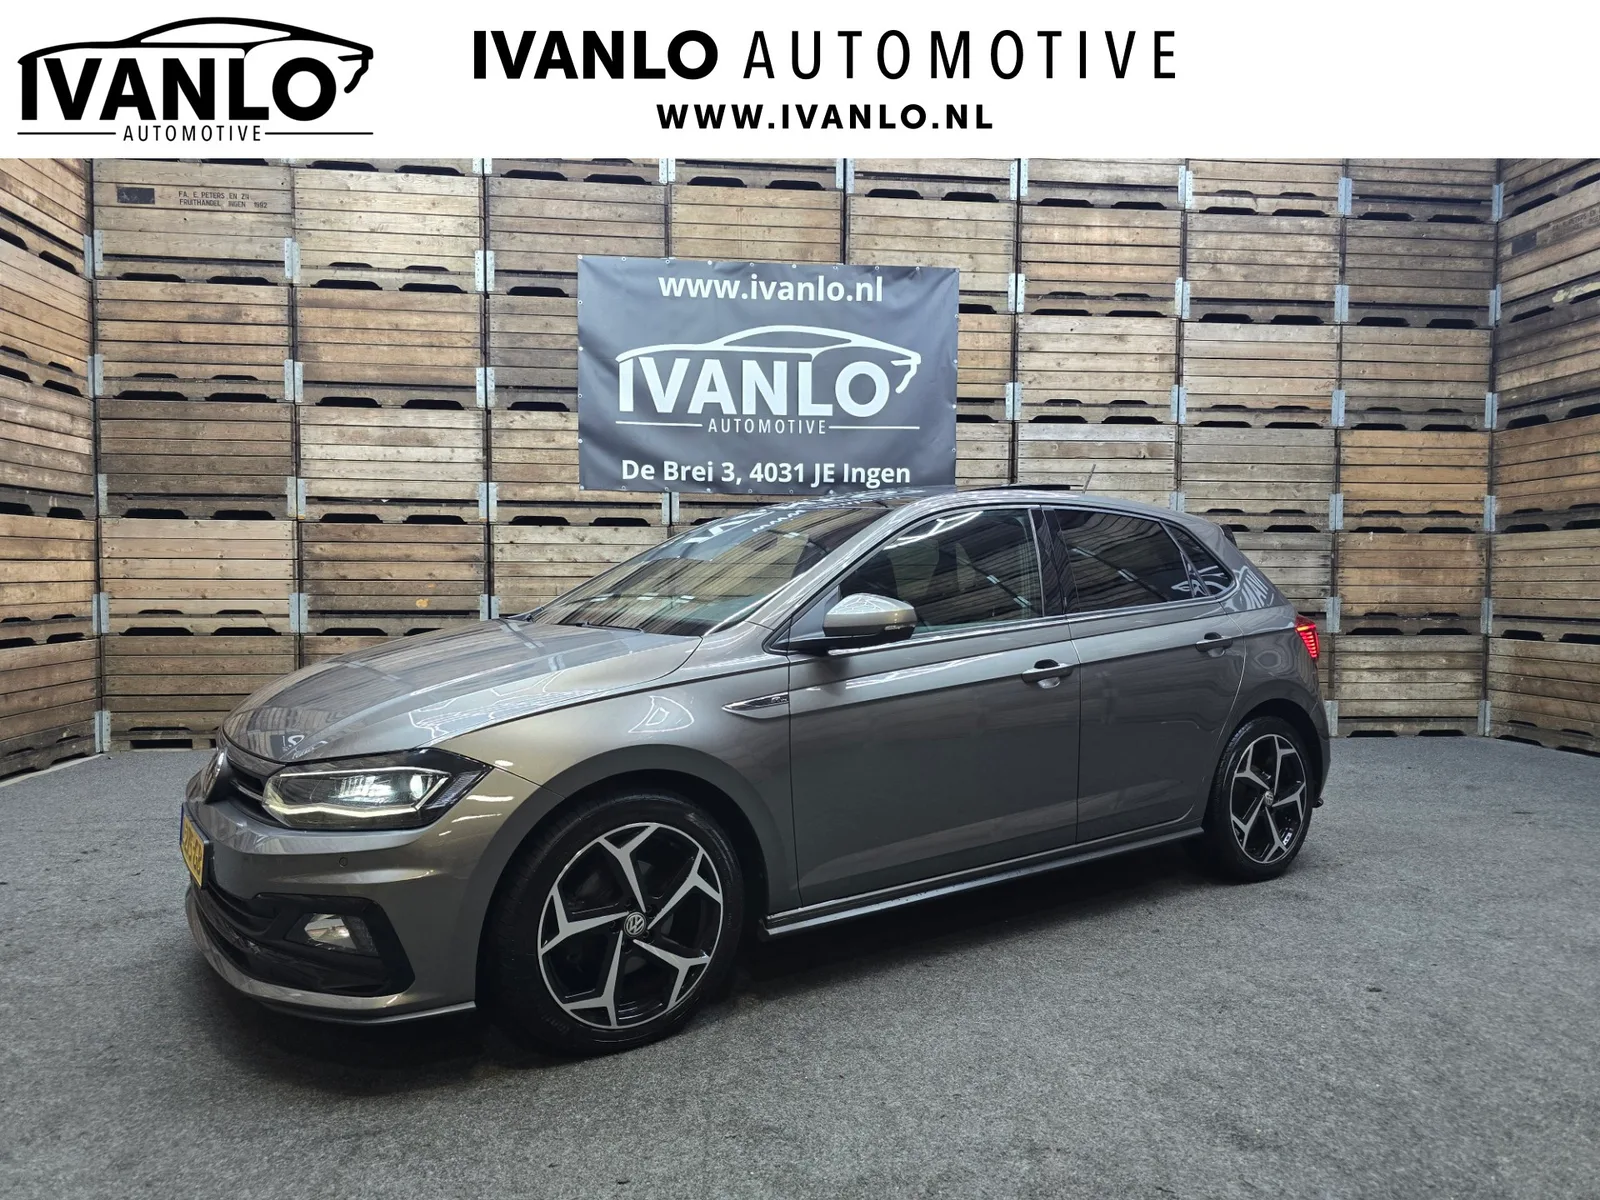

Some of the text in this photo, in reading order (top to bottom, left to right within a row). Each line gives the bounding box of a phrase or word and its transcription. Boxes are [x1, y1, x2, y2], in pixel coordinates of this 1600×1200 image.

[201, 191, 226, 199] PETERS
[229, 192, 238, 200] EN
[657, 273, 883, 302] www.ivanlo.nl
[618, 356, 890, 418] IVANLO
[707, 418, 827, 435] AUTOMOTIVE
[621, 459, 911, 488] De Brei 3, 4031 JE Ingen
